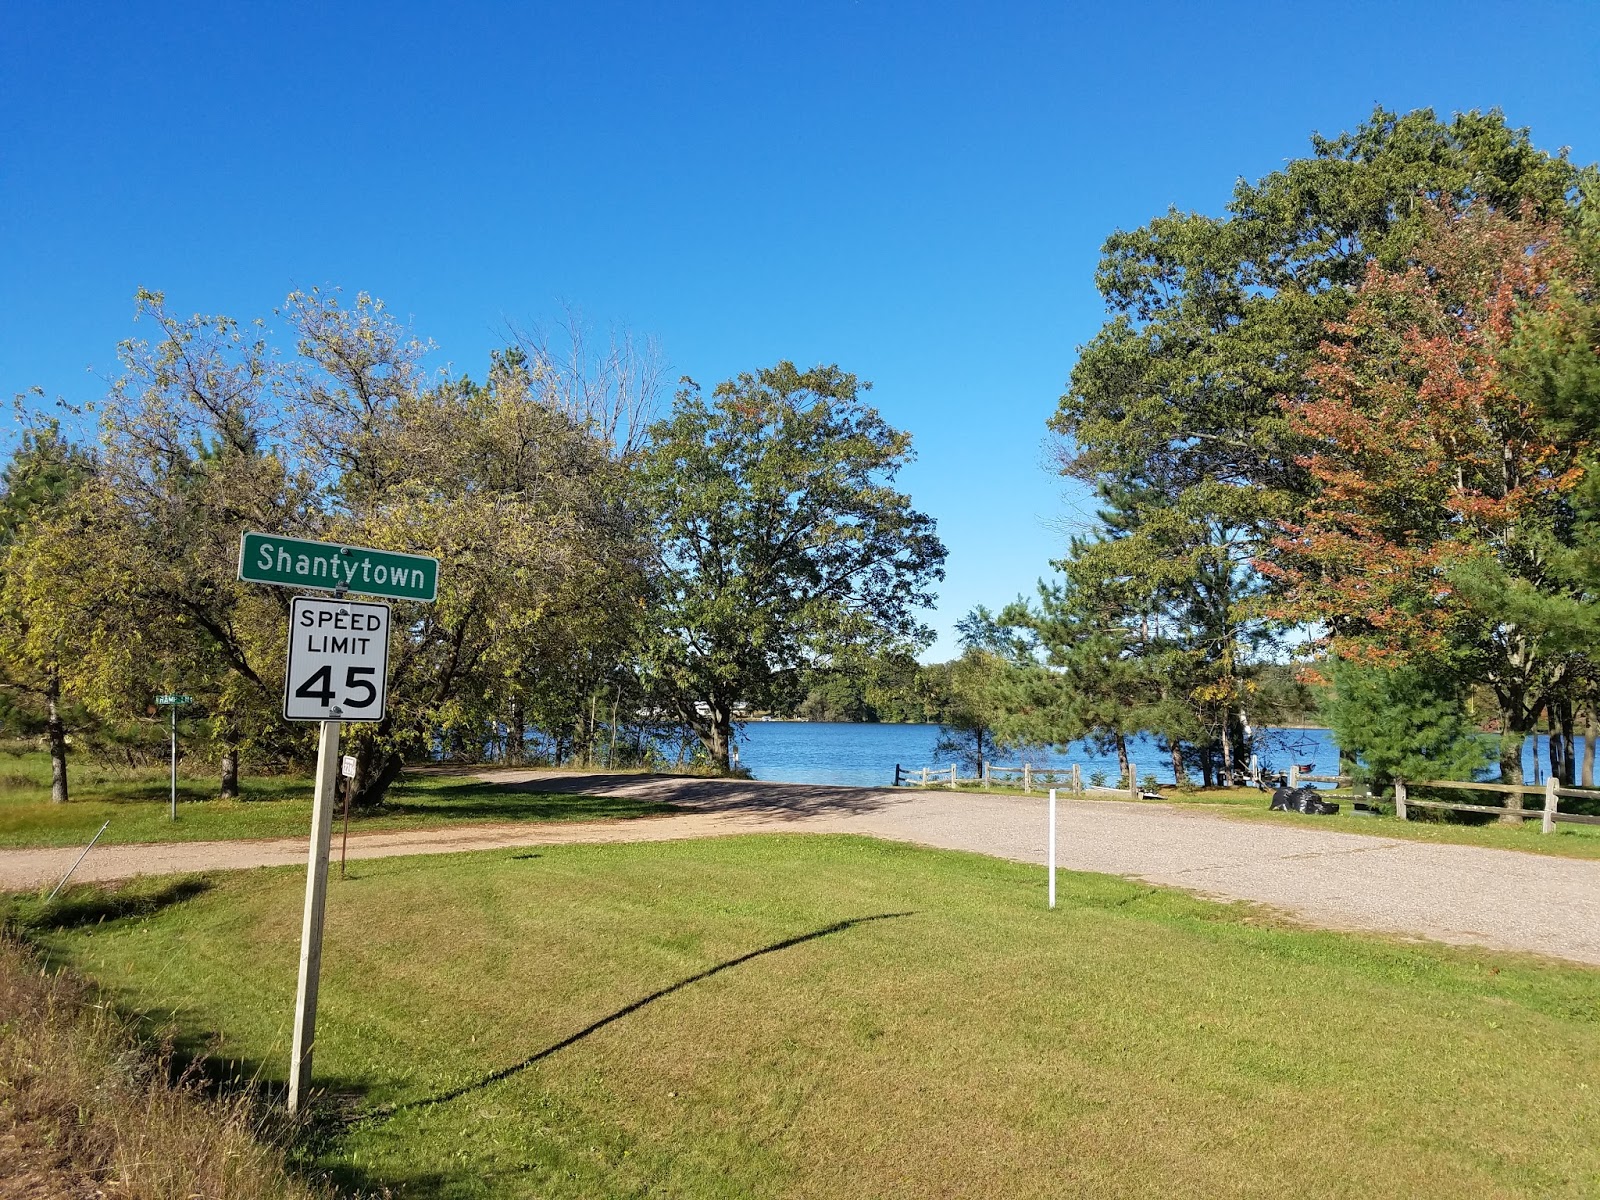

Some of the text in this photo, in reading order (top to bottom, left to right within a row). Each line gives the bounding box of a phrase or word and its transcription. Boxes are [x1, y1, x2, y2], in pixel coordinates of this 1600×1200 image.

[257, 543, 425, 589] Shantytown
[300, 609, 381, 631] SPEED
[307, 635, 371, 655] LIMIT
[295, 665, 377, 708] 45
